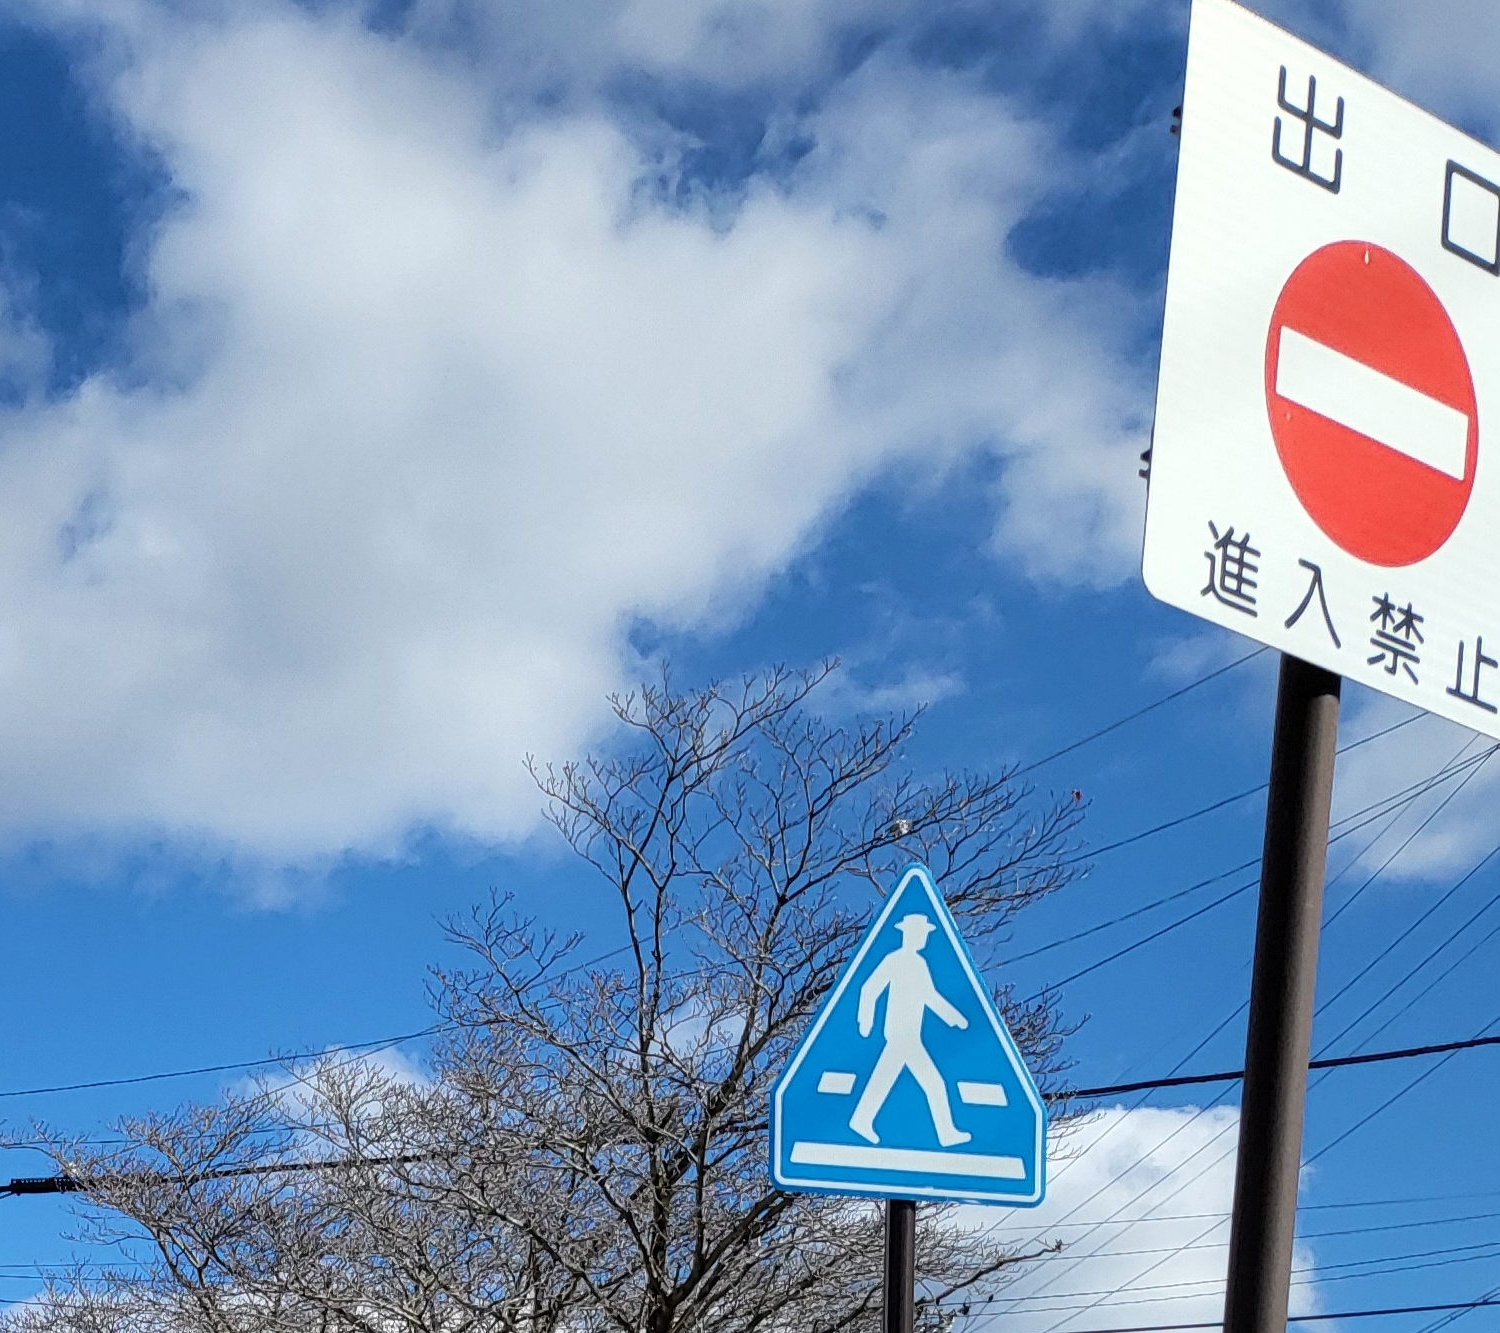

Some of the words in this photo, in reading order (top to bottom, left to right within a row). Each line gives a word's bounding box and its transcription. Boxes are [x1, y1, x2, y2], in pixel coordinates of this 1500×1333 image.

[1271, 64, 1500, 277] 出口
[1200, 520, 1500, 714] 進入禁止
